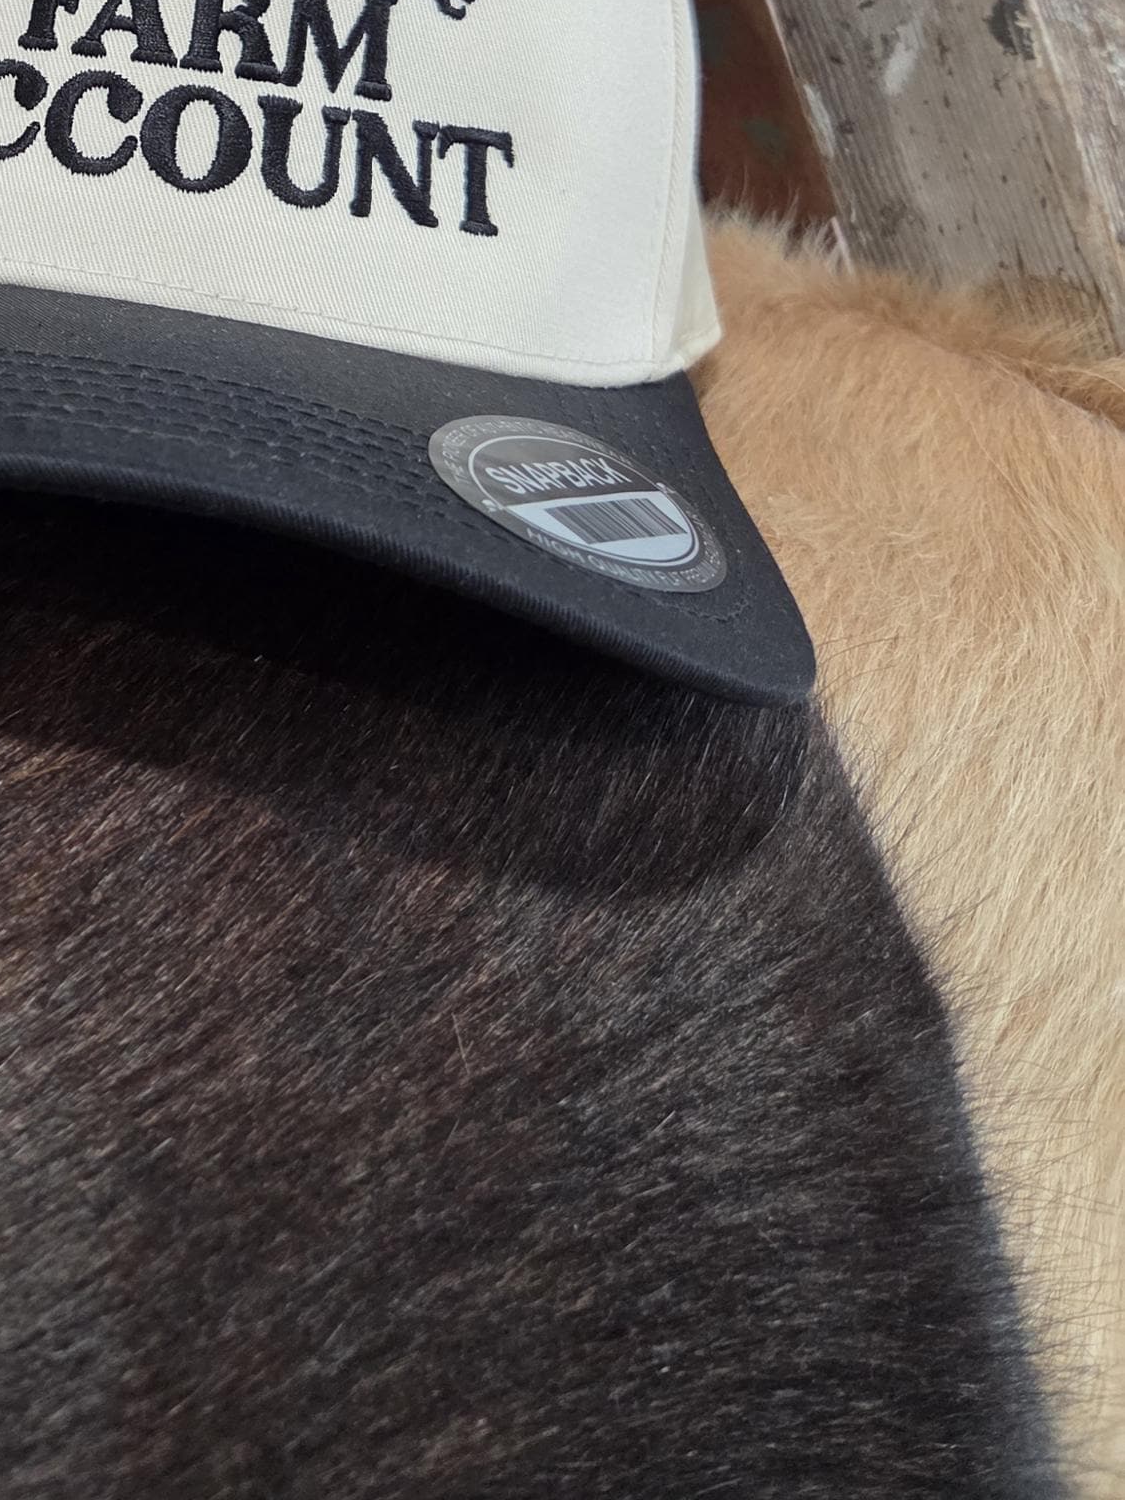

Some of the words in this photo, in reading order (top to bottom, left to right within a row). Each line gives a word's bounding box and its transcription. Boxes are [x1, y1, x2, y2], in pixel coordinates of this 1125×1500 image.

[485, 457, 632, 495] SNAPBACK
[525, 527, 584, 562] HIGH
[587, 554, 659, 582] QUALITY
